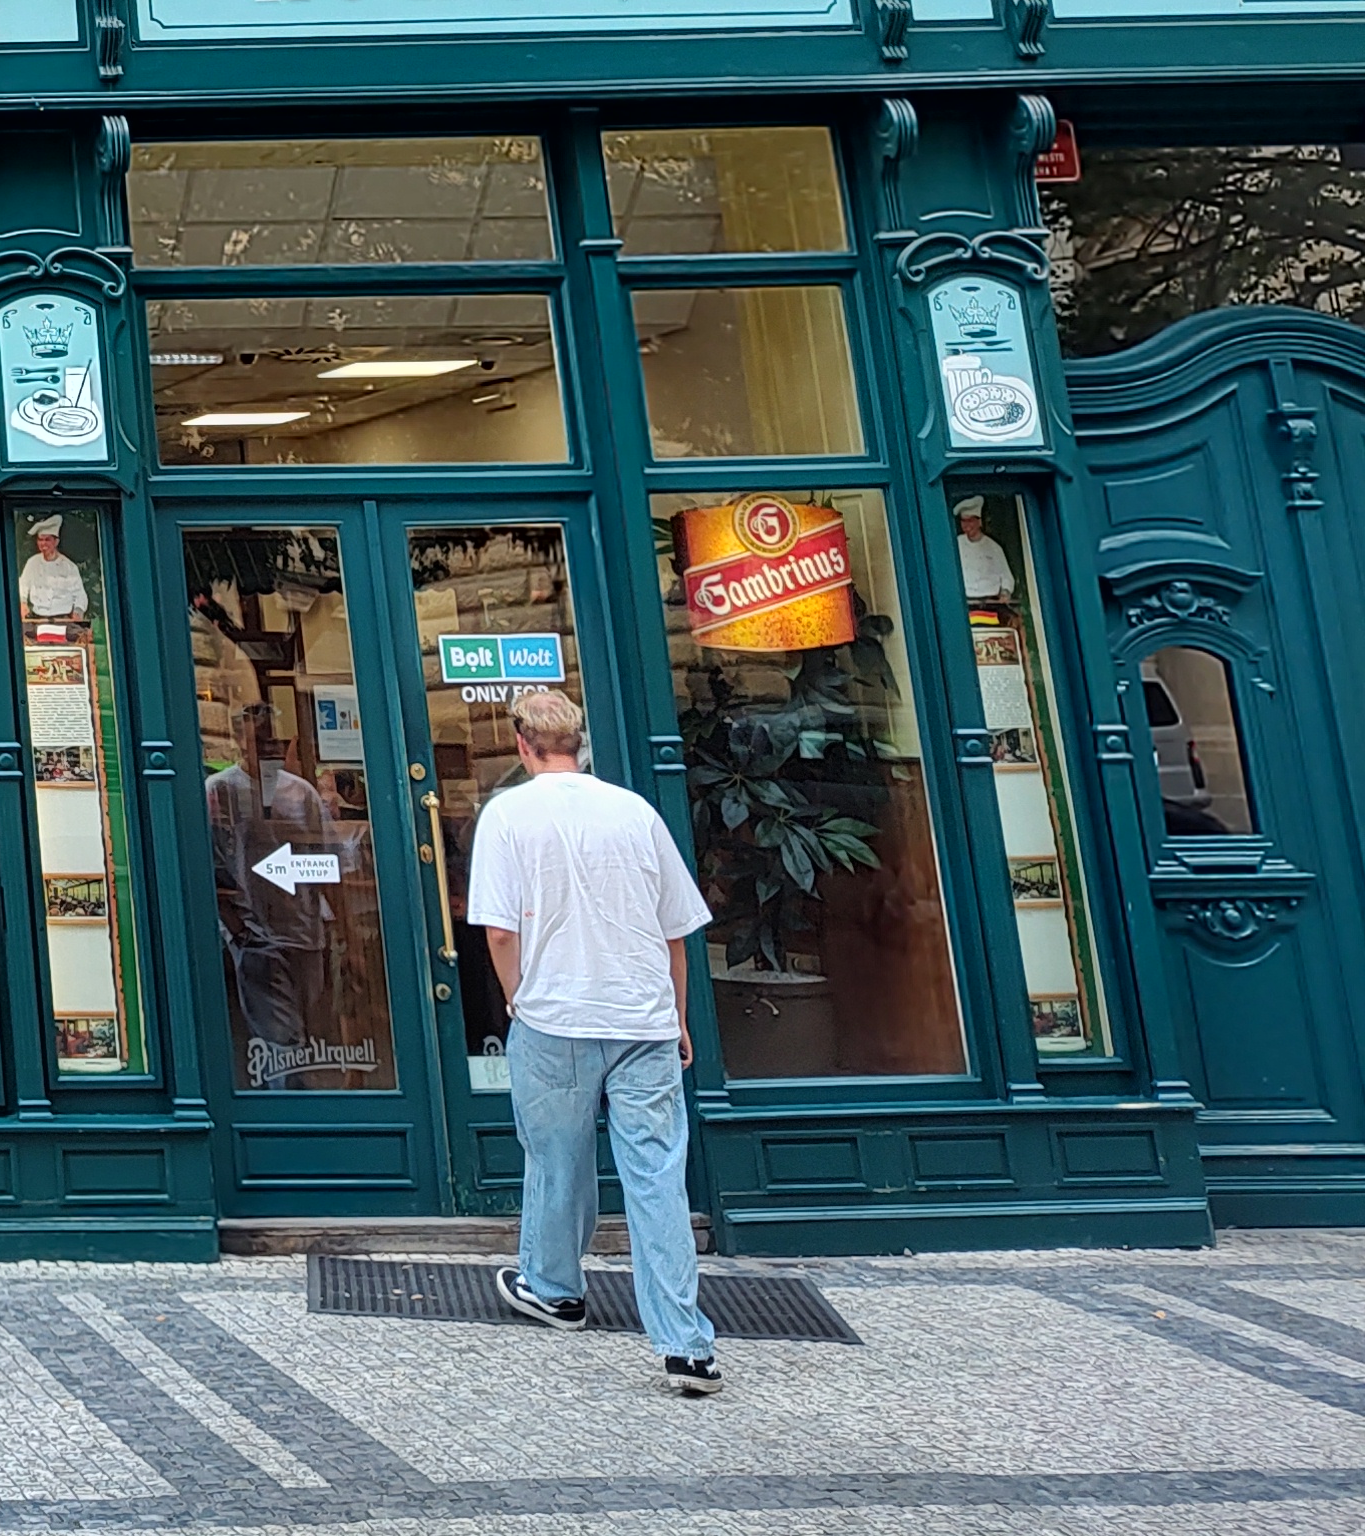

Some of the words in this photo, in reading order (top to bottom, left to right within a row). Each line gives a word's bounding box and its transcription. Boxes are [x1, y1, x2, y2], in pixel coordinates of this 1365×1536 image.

[694, 547, 846, 616] Gambrinus
[450, 647, 494, 672] Bolt
[509, 648, 554, 666] Wolt
[461, 685, 509, 703] ONLY
[247, 1036, 313, 1088] Pilsner
[309, 1036, 376, 1074] Urquell
